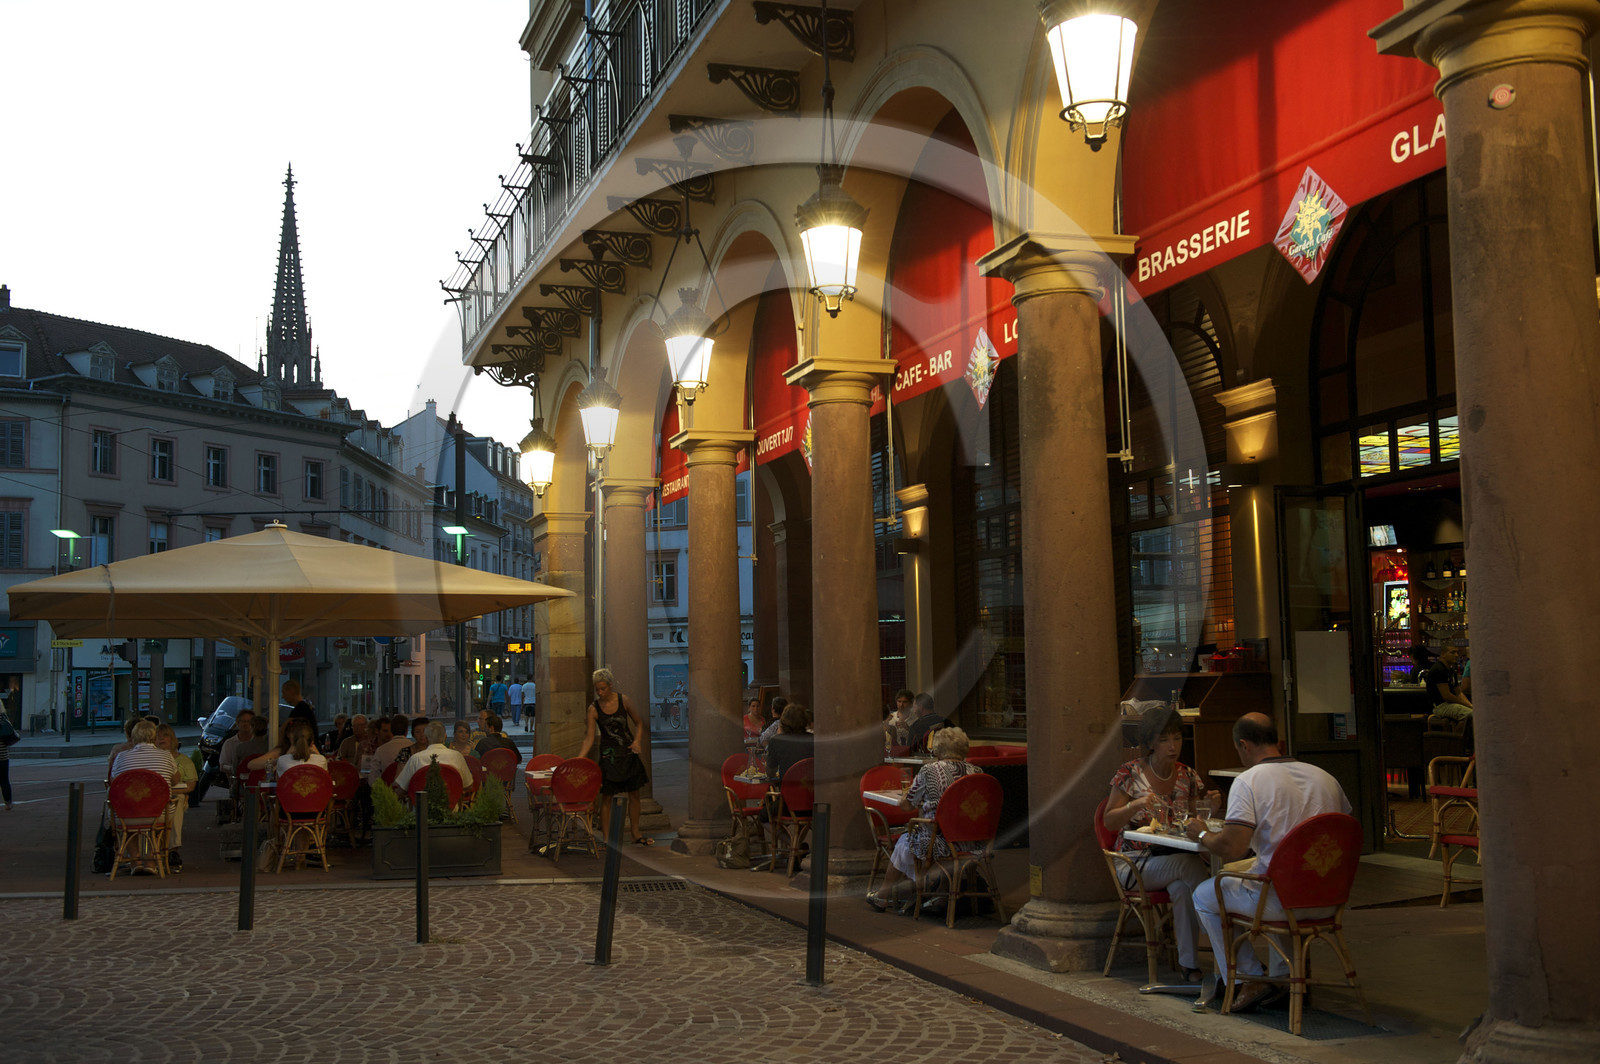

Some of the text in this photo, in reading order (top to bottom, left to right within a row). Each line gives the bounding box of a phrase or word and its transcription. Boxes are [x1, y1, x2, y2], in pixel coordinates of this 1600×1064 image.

[1138, 209, 1250, 282] BRASSERIE
[1288, 228, 1333, 256] Garden Café
[756, 431, 781, 456] OUVERT
